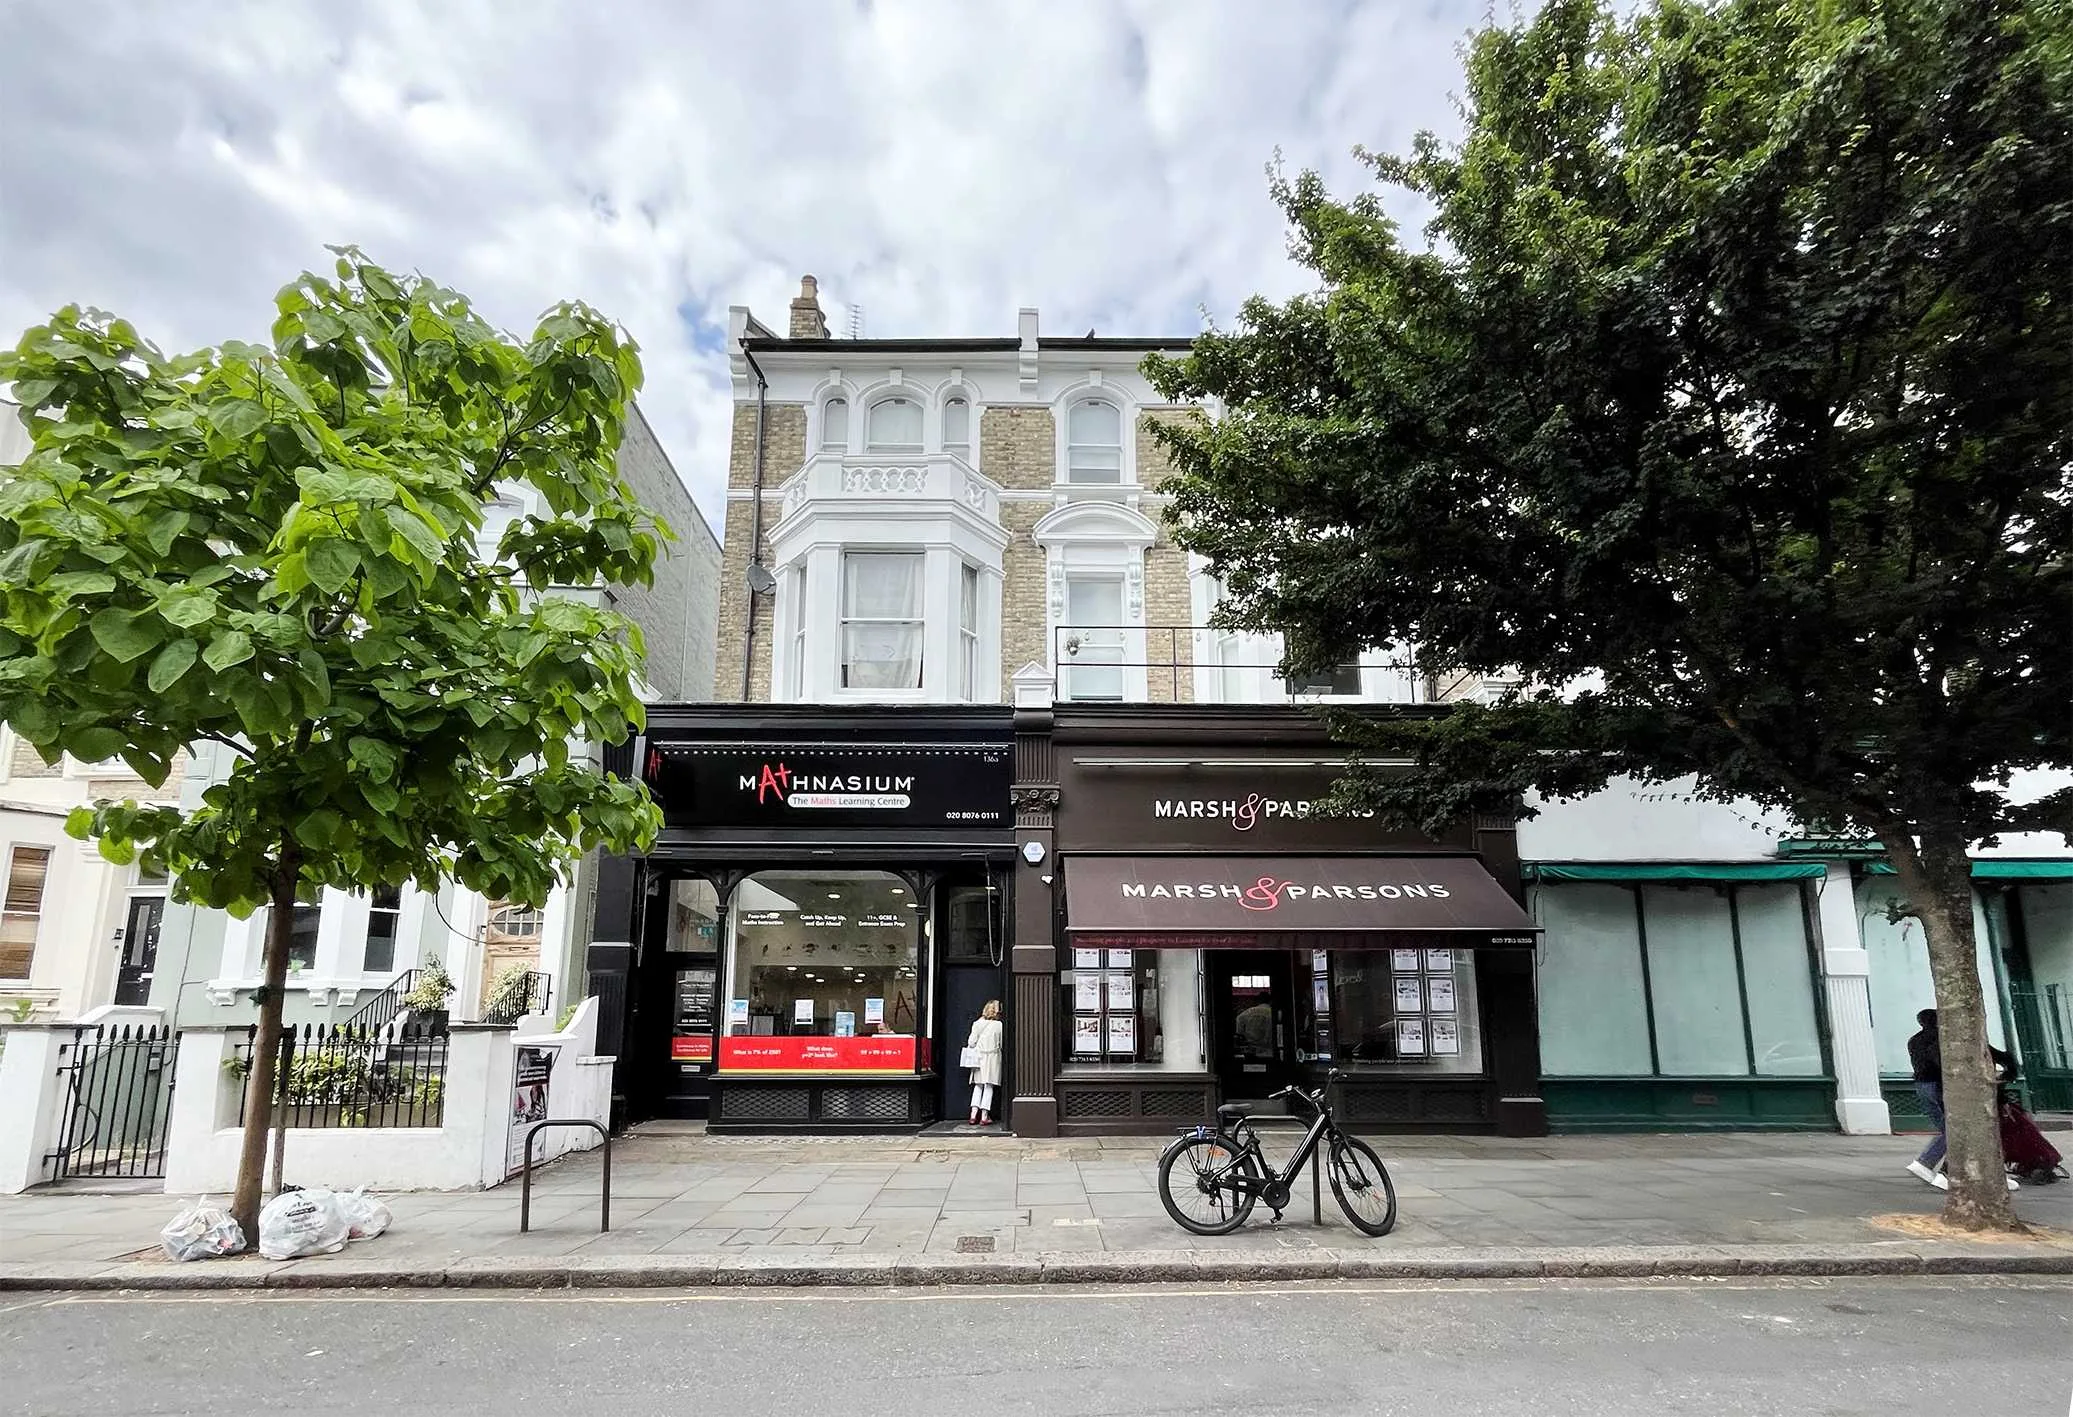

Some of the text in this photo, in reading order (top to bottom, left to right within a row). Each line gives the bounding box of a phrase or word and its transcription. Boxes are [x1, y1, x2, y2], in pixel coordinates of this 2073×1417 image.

[793, 796, 905, 808] The Maths Learning Centre
[1155, 800, 1236, 818] MARSH
[1232, 792, 1268, 831] &
[1121, 877, 1451, 911] MARSH & PARSONS
